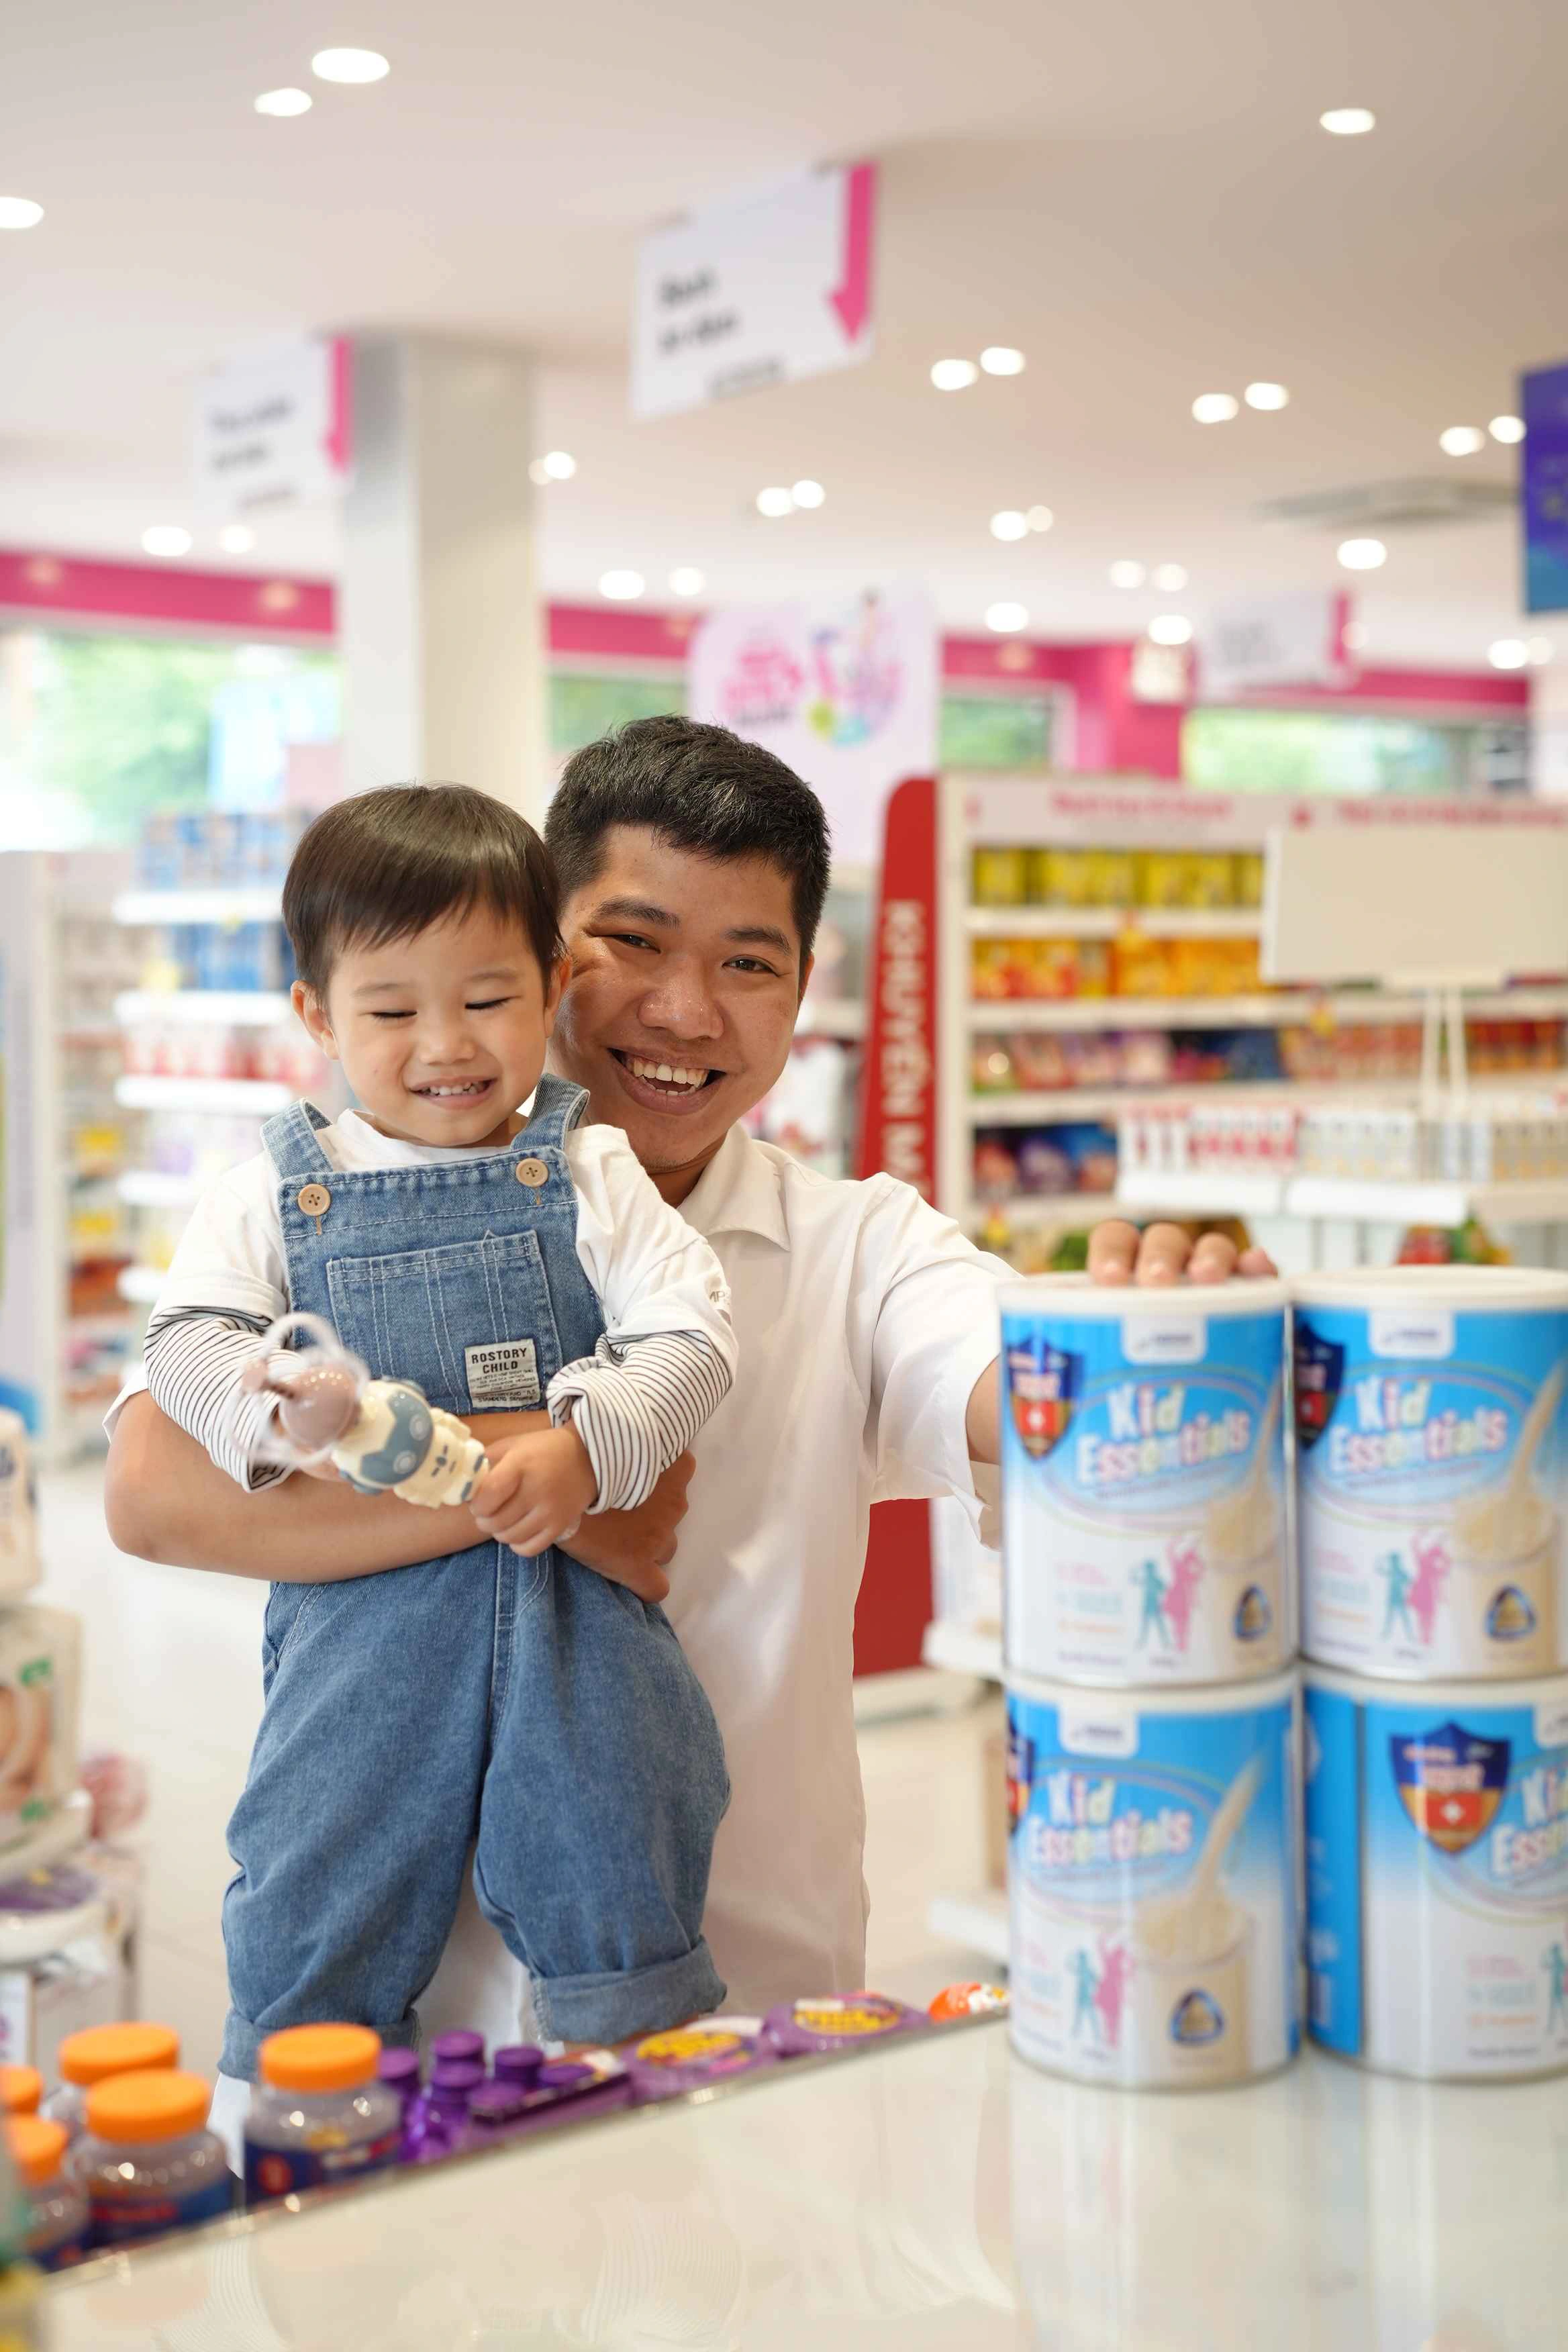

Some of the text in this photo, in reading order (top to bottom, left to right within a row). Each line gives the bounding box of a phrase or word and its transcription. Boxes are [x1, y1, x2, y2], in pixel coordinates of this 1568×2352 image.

[471, 1347, 527, 1364] ROSTORY
[483, 1361, 518, 1374] CHILD
[1106, 1380, 1186, 1441] Kid
[1355, 1373, 1432, 1432] Kid
[1075, 1408, 1251, 1483] Essentials
[1329, 1405, 1508, 1472] Essentials
[1047, 1769, 1116, 1826] Kid
[1027, 1806, 1193, 1867] Essentials
